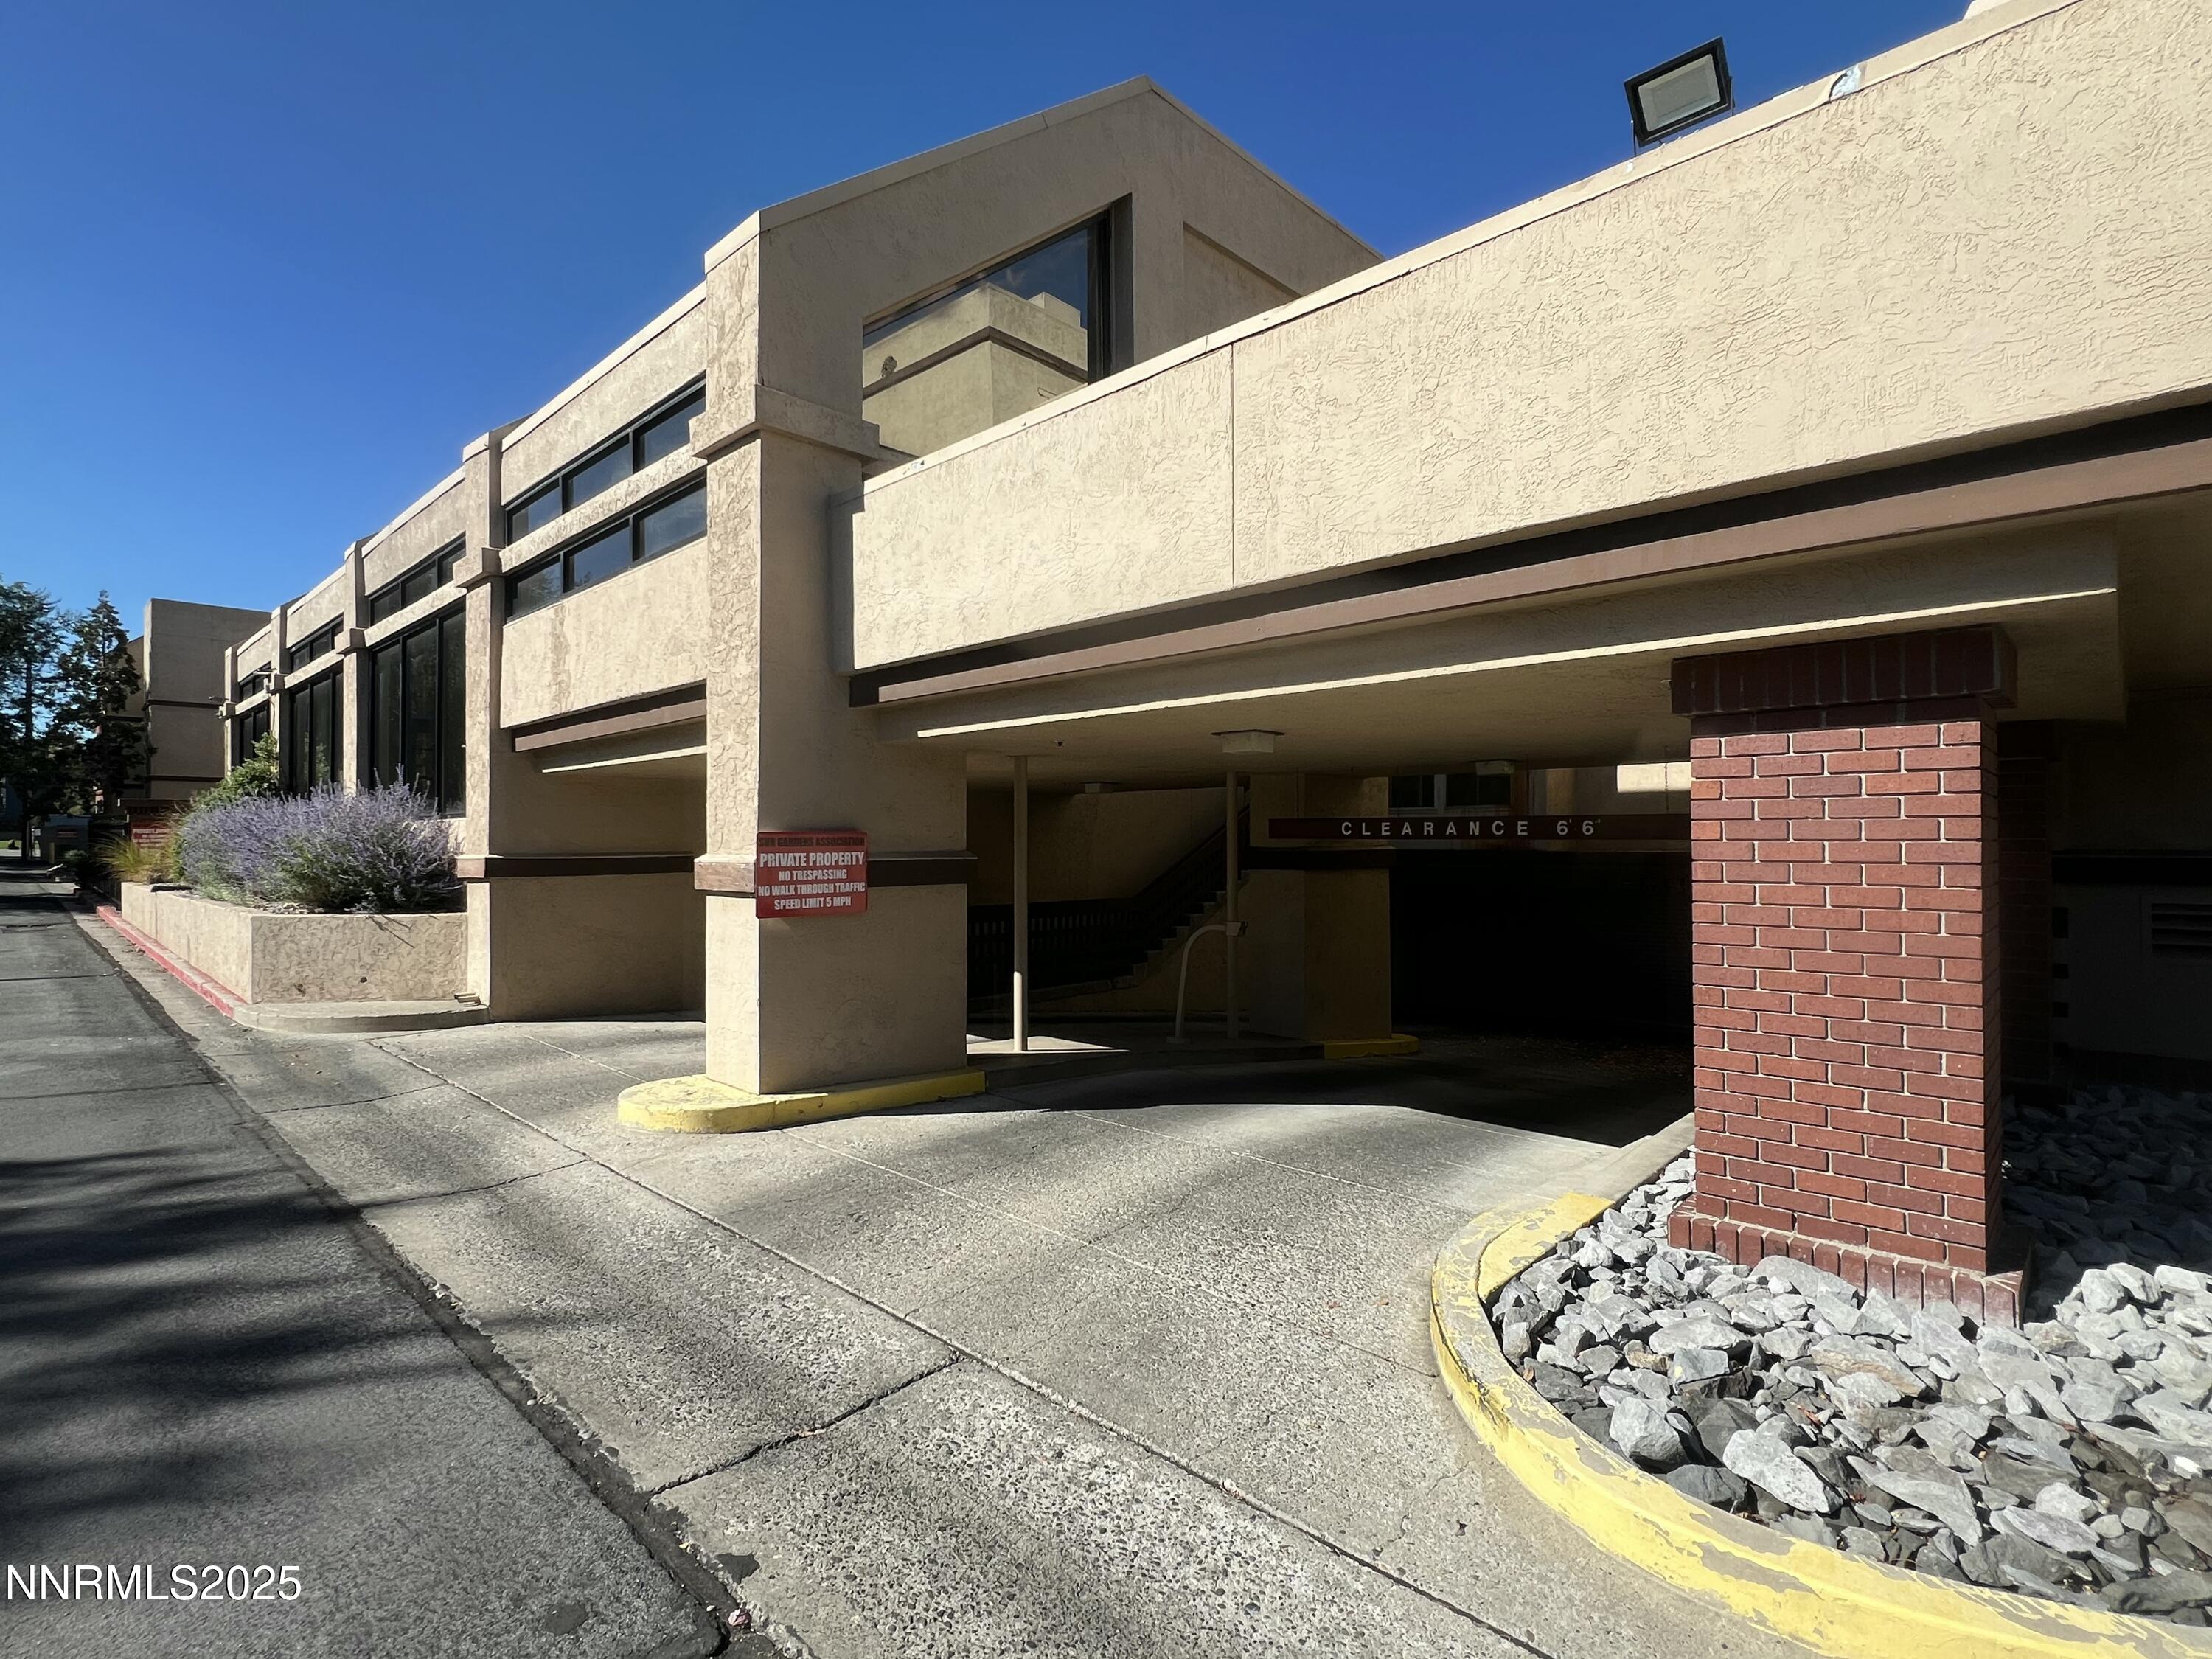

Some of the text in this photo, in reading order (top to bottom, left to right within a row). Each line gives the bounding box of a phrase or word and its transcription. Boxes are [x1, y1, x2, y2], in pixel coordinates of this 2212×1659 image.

[1341, 821, 1528, 836] CLEARANCE
[760, 852, 865, 867] PRIVATE PROPERTY
[779, 869, 847, 881] NO TRESPASSING
[758, 882, 866, 897] NO WALK THROUGH TRAFFIC
[774, 896, 851, 910] SPEED LIMIT 5 MPH
